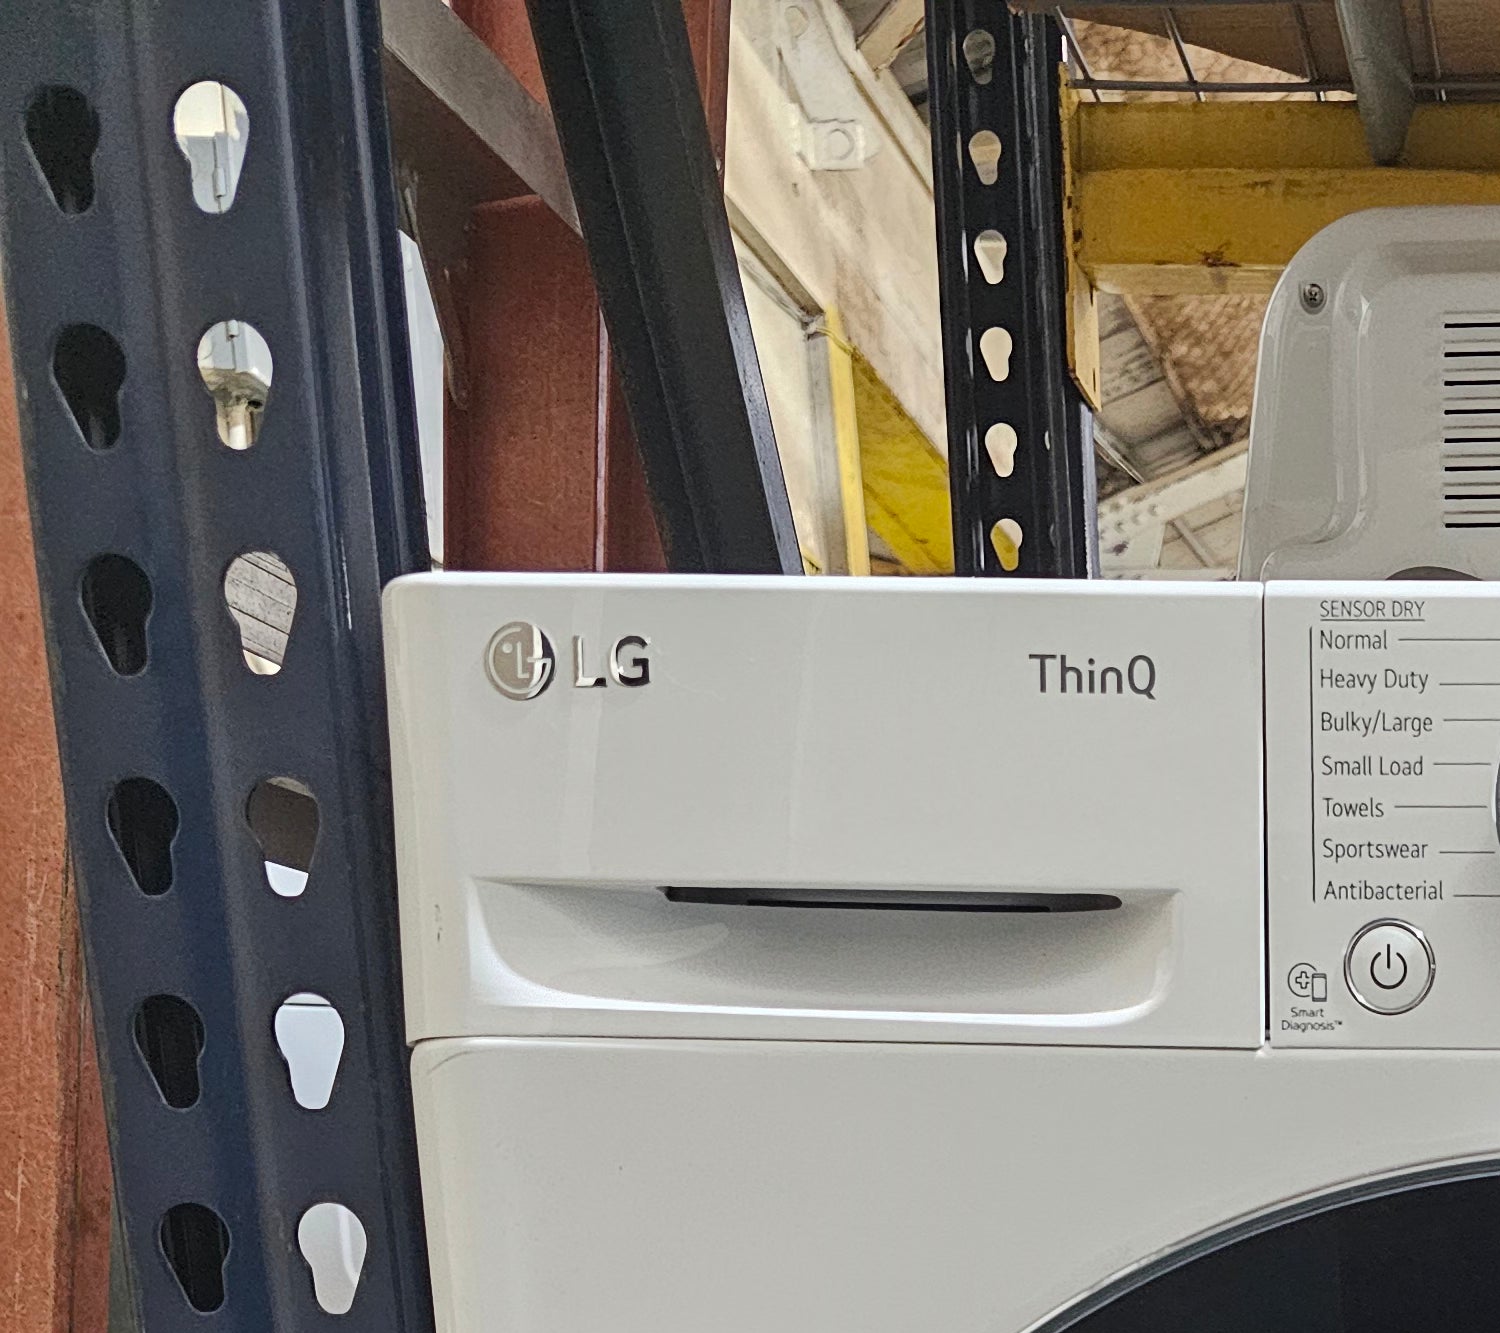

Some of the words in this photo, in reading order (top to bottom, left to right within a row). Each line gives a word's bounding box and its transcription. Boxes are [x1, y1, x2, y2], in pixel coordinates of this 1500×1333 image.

[1320, 600, 1386, 618] SENSOR
[1392, 601, 1425, 618] DRY
[1320, 629, 1388, 650] Normal
[572, 635, 651, 688] LG
[1029, 654, 1156, 700] ThinQ
[1320, 668, 1377, 694] Heavy
[1384, 668, 1429, 694] Duty
[1321, 709, 1433, 738] Bulky/Large
[1321, 755, 1372, 776] Small
[1380, 755, 1423, 776] Load
[1322, 797, 1384, 818] Towels
[1322, 838, 1428, 863] Sportswear
[1323, 880, 1443, 900] Antibacterial
[1291, 1007, 1324, 1018] Smart
